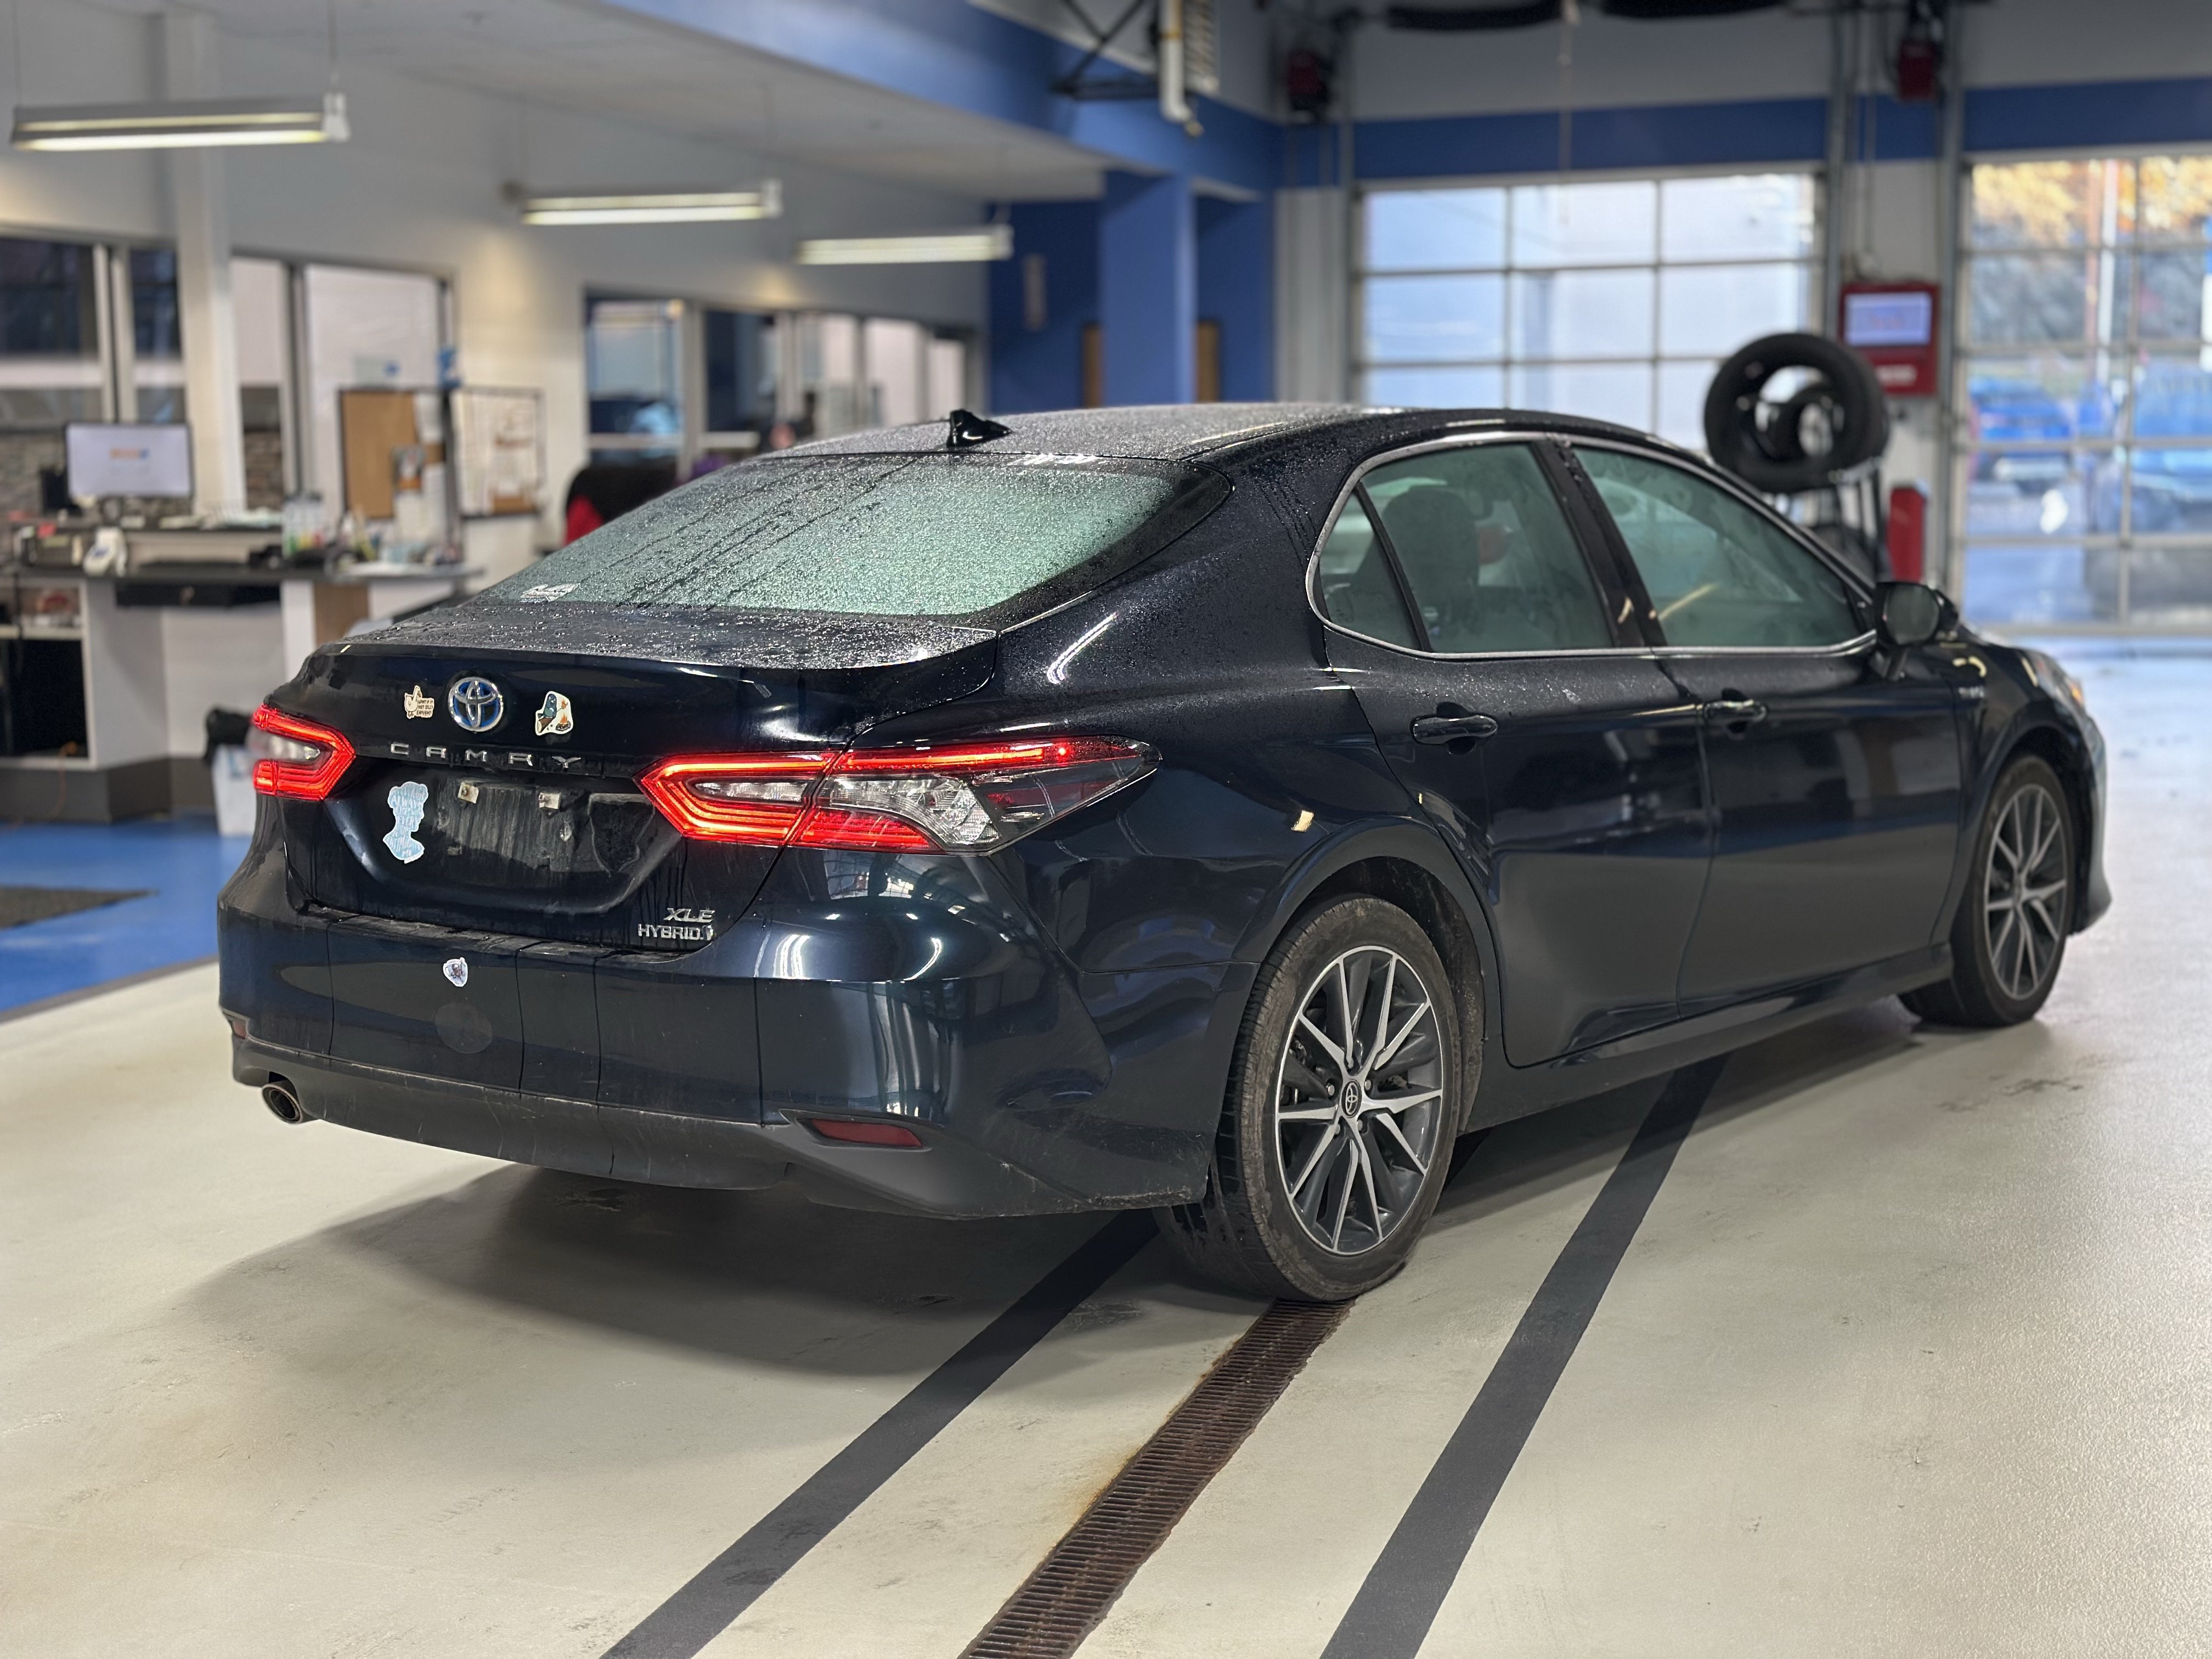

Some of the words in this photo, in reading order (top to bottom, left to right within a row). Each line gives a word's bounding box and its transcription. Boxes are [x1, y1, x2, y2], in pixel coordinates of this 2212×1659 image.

[391, 742, 581, 769] CAMRY
[663, 907, 715, 923] XLE
[637, 923, 701, 940] HYBRID
